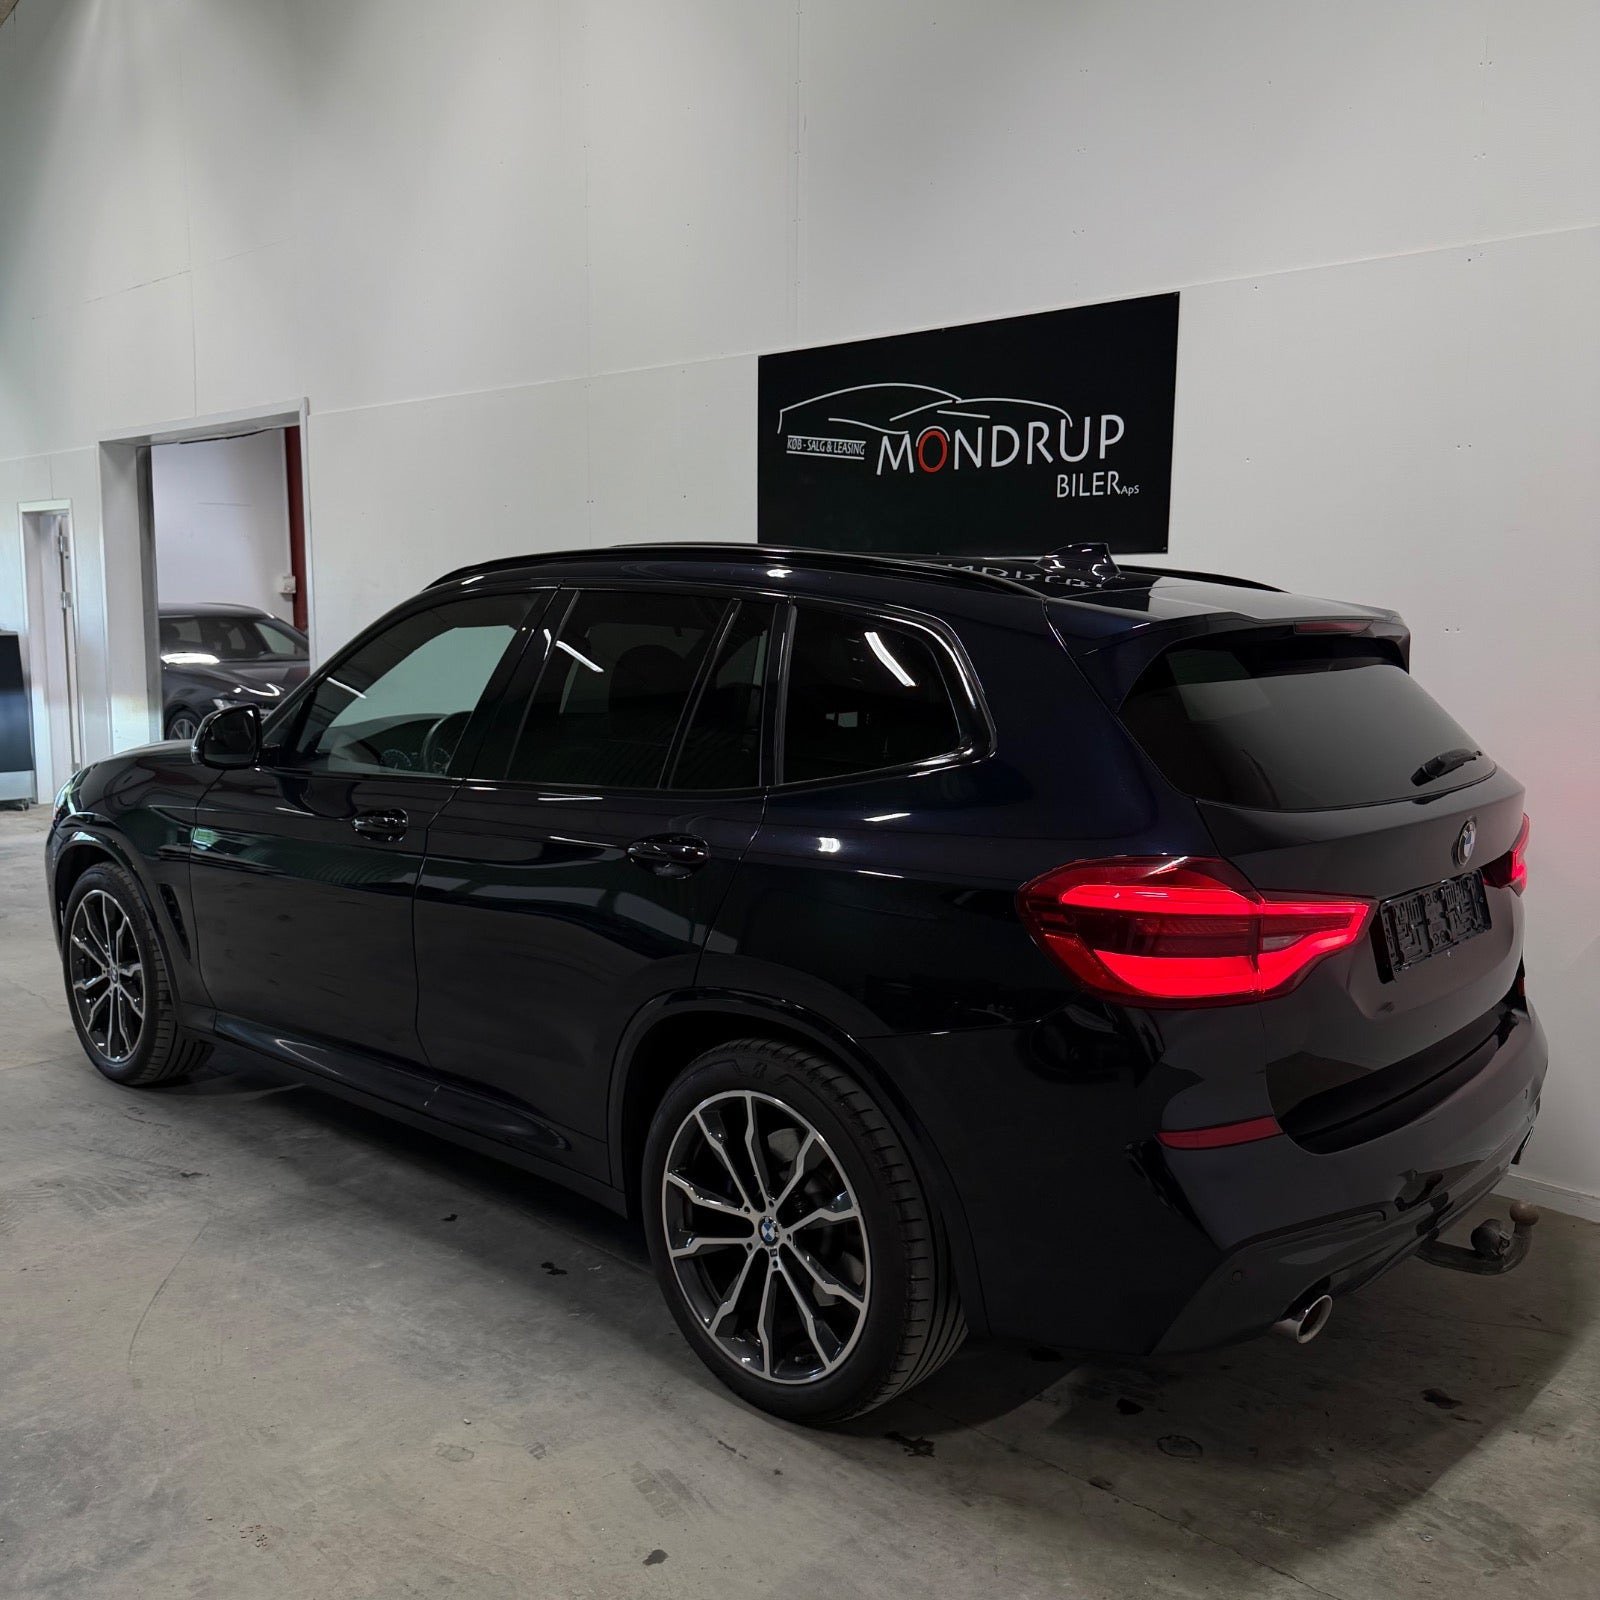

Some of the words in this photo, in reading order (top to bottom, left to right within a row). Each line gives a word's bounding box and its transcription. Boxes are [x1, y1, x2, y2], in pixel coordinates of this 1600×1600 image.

[807, 440, 825, 452] SALG
[826, 441, 832, 452] &
[833, 442, 865, 455] LEASING
[876, 414, 1125, 476] MONDRUP
[1056, 470, 1121, 498] BILER
[1120, 484, 1140, 495] ApS
